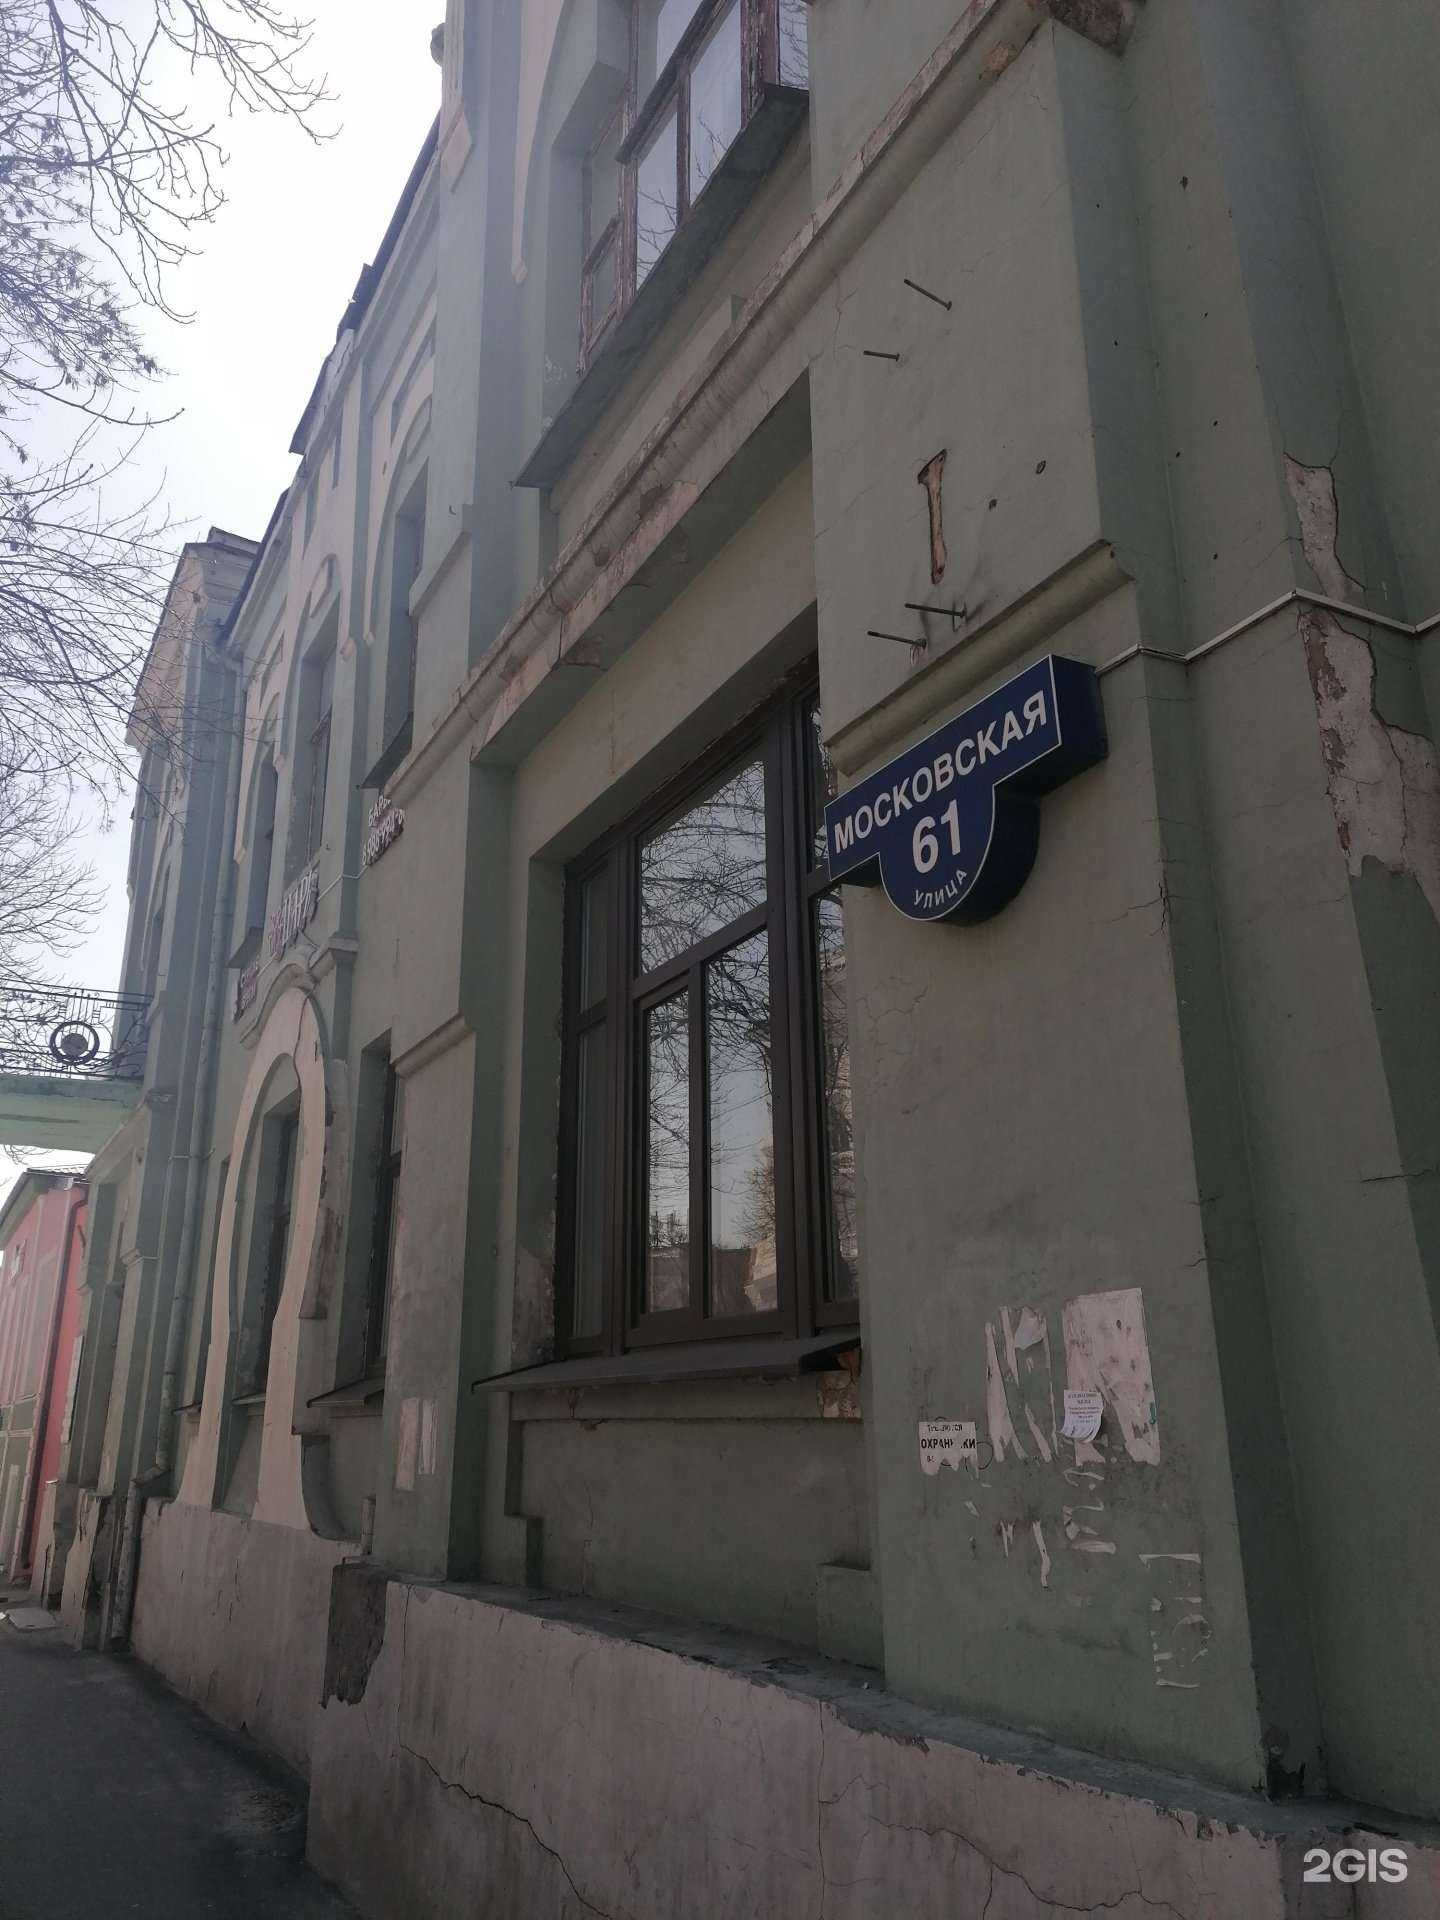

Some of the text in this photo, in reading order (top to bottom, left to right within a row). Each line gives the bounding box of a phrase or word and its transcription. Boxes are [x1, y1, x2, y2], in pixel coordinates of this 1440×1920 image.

[834, 690, 1047, 854] МОСКОВСКАЯ
[912, 799, 961, 874] 61
[913, 868, 967, 909] УЛИЦА
[921, 1438, 976, 1449] ОХРАНКИ
